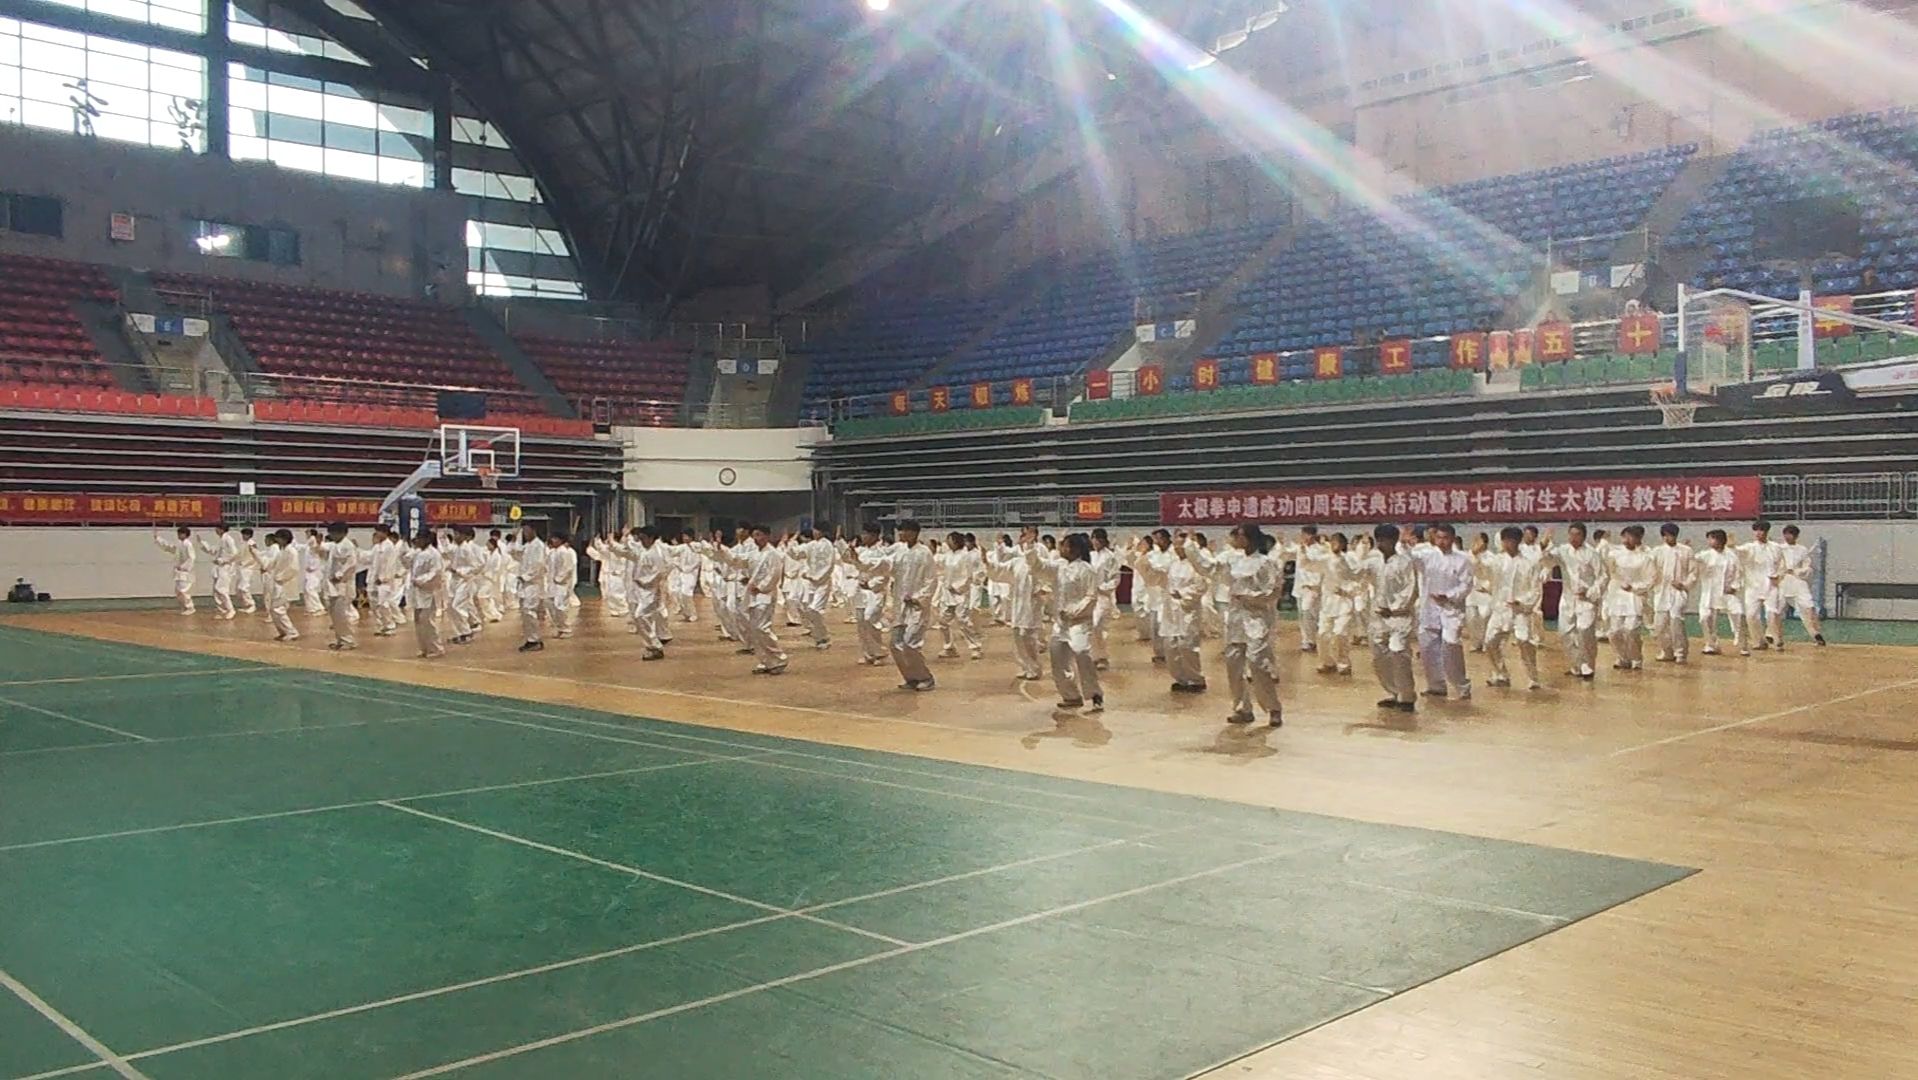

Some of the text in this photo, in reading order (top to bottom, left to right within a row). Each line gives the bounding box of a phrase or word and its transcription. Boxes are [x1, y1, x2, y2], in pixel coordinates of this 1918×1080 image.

[1178, 484, 1734, 519] 太极拳申遗成功四周年庆典活动暨第七届新生太极拳教学比赛
